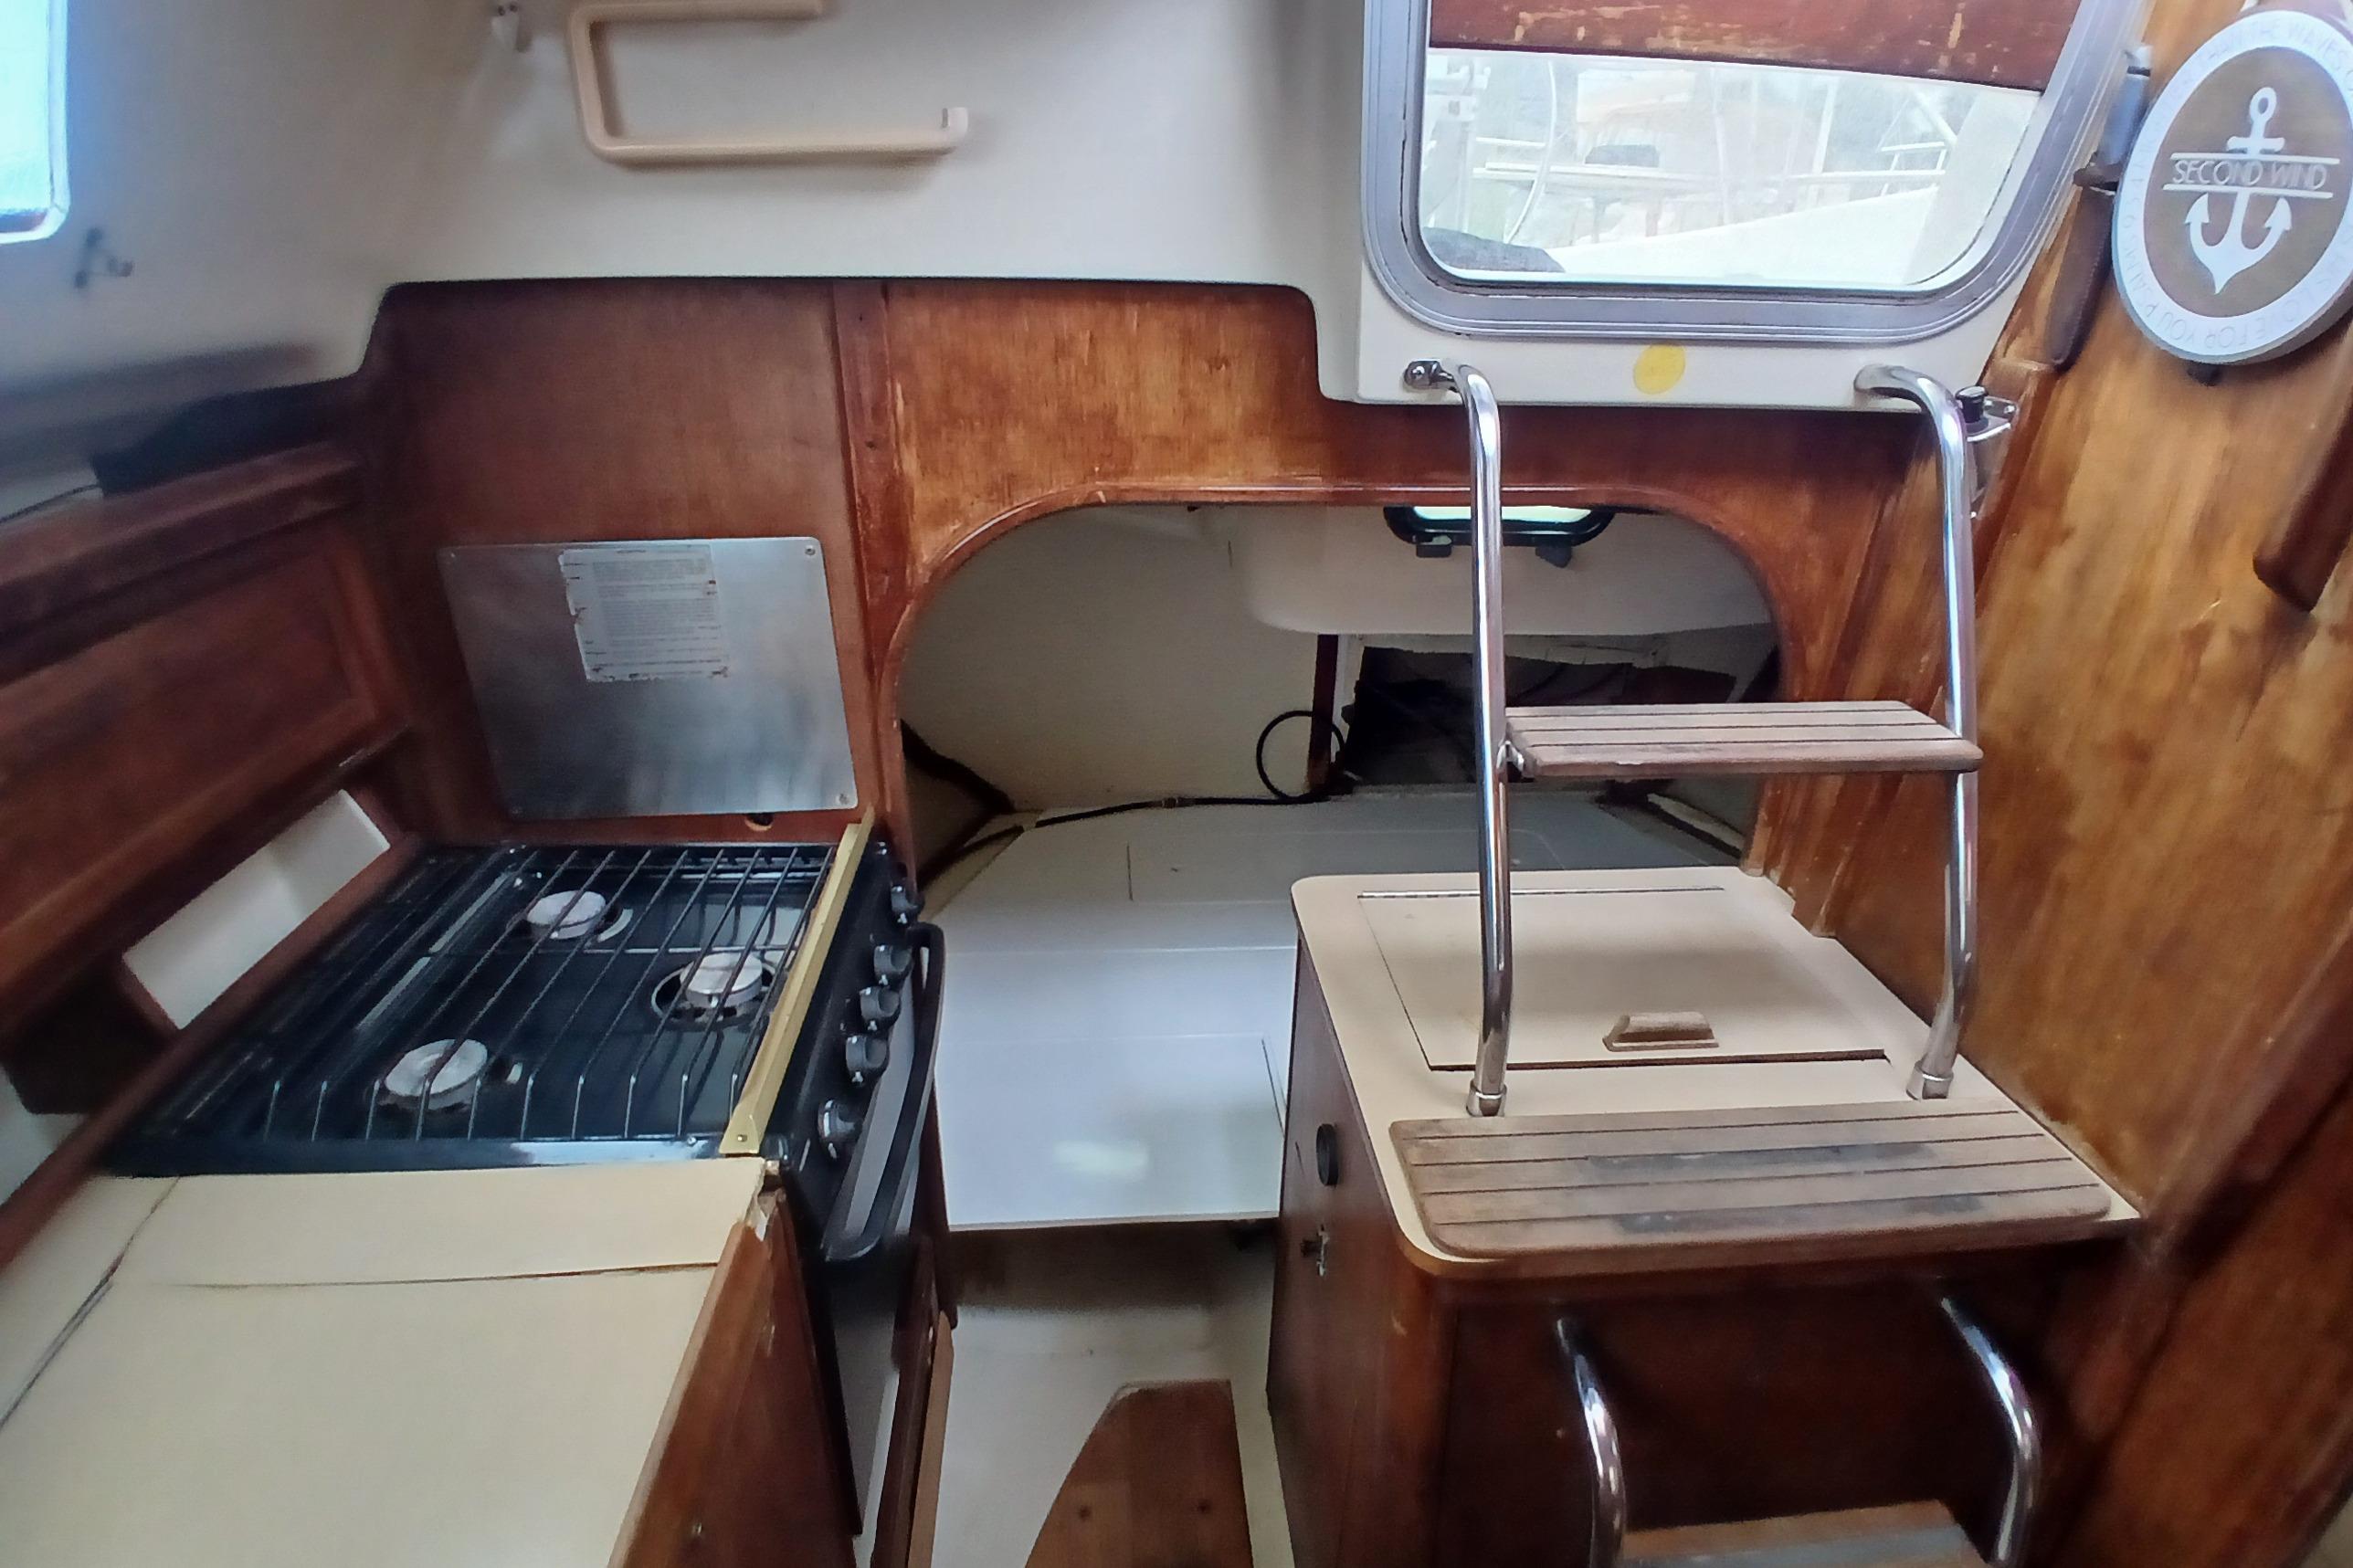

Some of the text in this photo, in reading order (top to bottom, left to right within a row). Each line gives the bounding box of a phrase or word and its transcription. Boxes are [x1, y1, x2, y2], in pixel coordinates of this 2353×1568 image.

[2172, 159, 2327, 191] SECOND WIND
[2156, 307, 2199, 349] YOU
[2202, 323, 2249, 350] FOR
